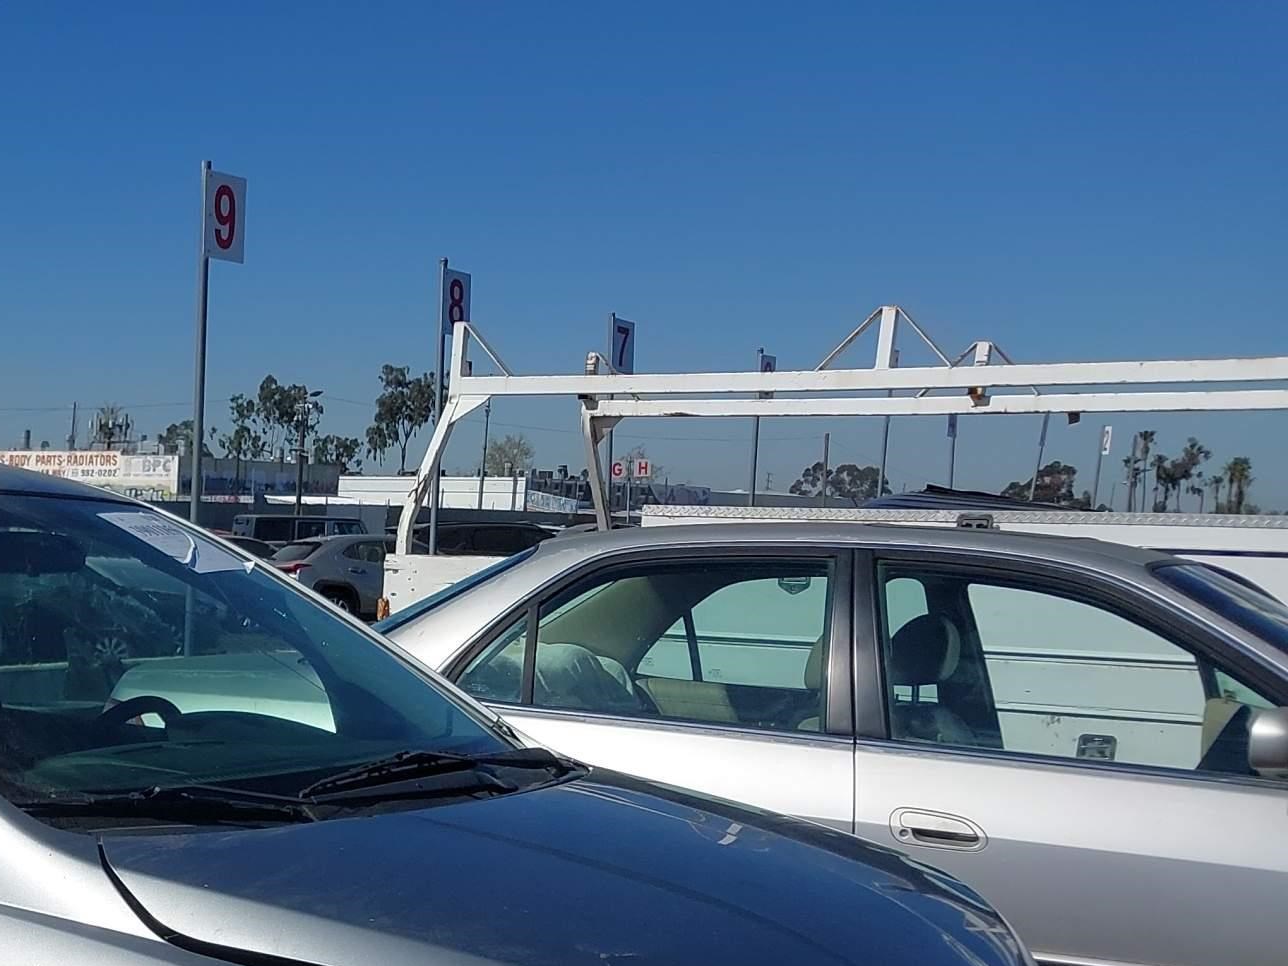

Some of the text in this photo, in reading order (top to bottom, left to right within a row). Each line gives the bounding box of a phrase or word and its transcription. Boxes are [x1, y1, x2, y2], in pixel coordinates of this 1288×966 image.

[214, 184, 236, 250] 9
[448, 278, 464, 327] 8
[617, 326, 630, 368] 7
[613, 462, 623, 477] G
[638, 461, 648, 475] H
